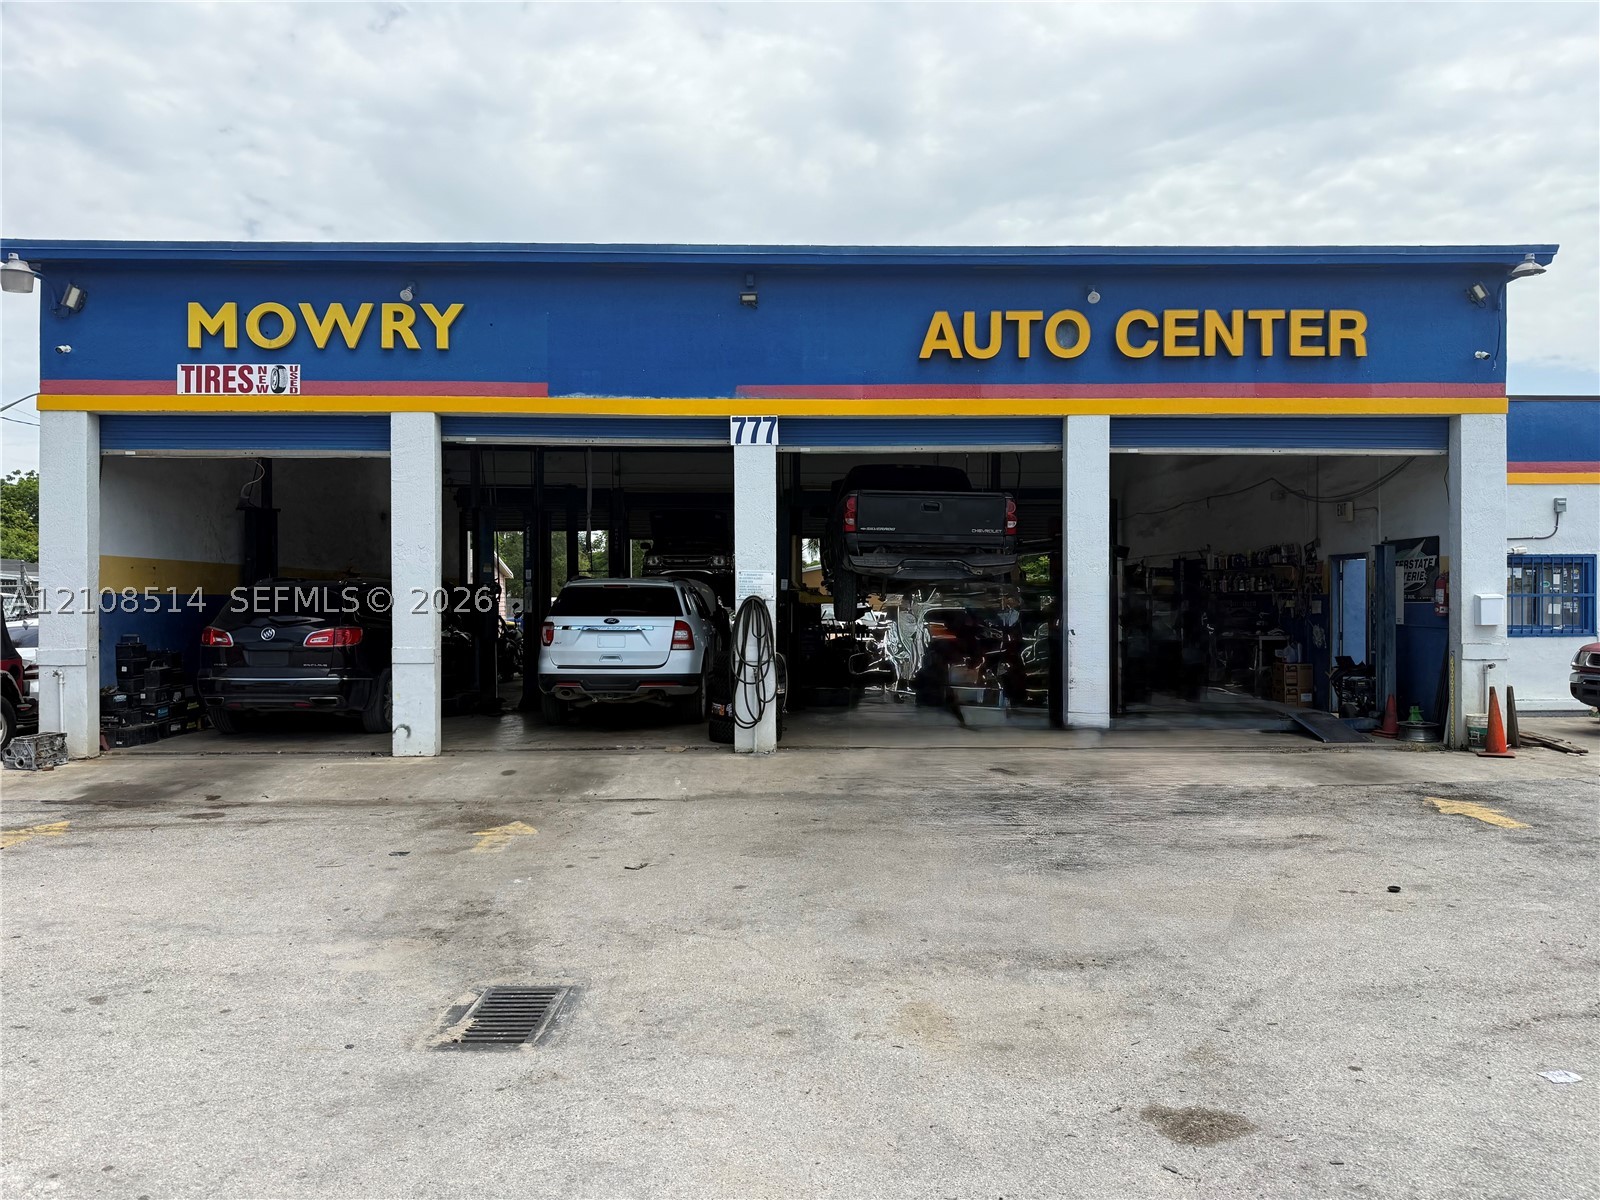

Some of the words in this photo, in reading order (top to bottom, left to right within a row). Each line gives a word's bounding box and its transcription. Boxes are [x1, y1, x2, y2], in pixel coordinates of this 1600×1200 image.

[187, 302, 465, 350] MOWRY
[918, 309, 1092, 360] AUTO
[1115, 309, 1369, 359] CENTER
[181, 365, 254, 394] TIRES
[256, 366, 269, 393] NEW
[289, 365, 299, 394] USED
[732, 416, 777, 444] 777
[1395, 557, 1433, 569] TERSTATE
